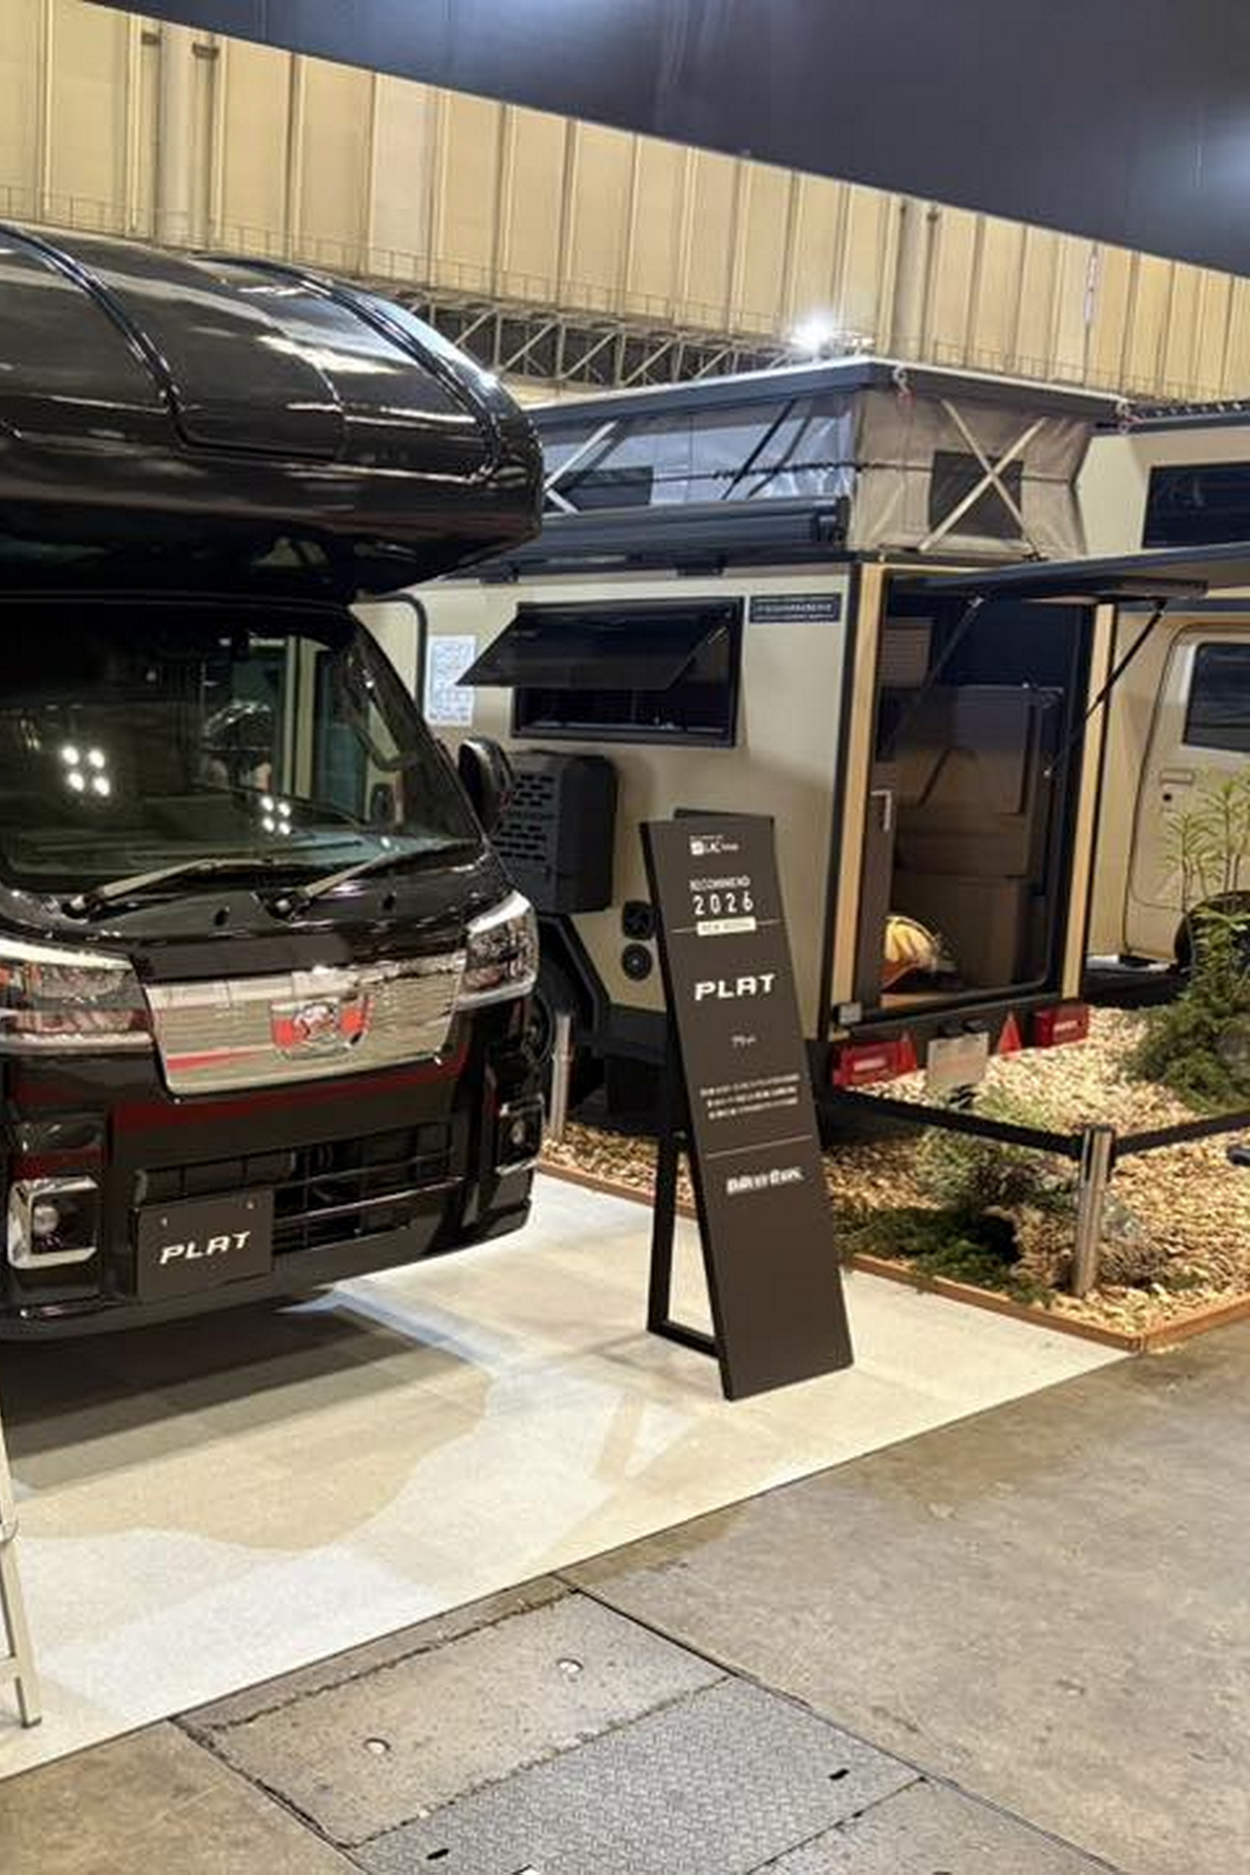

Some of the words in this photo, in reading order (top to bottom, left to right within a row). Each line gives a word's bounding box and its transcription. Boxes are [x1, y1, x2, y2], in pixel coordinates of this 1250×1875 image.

[693, 892, 754, 915] 2026
[695, 973, 775, 1001] PLAT
[159, 1231, 251, 1265] PLAT
